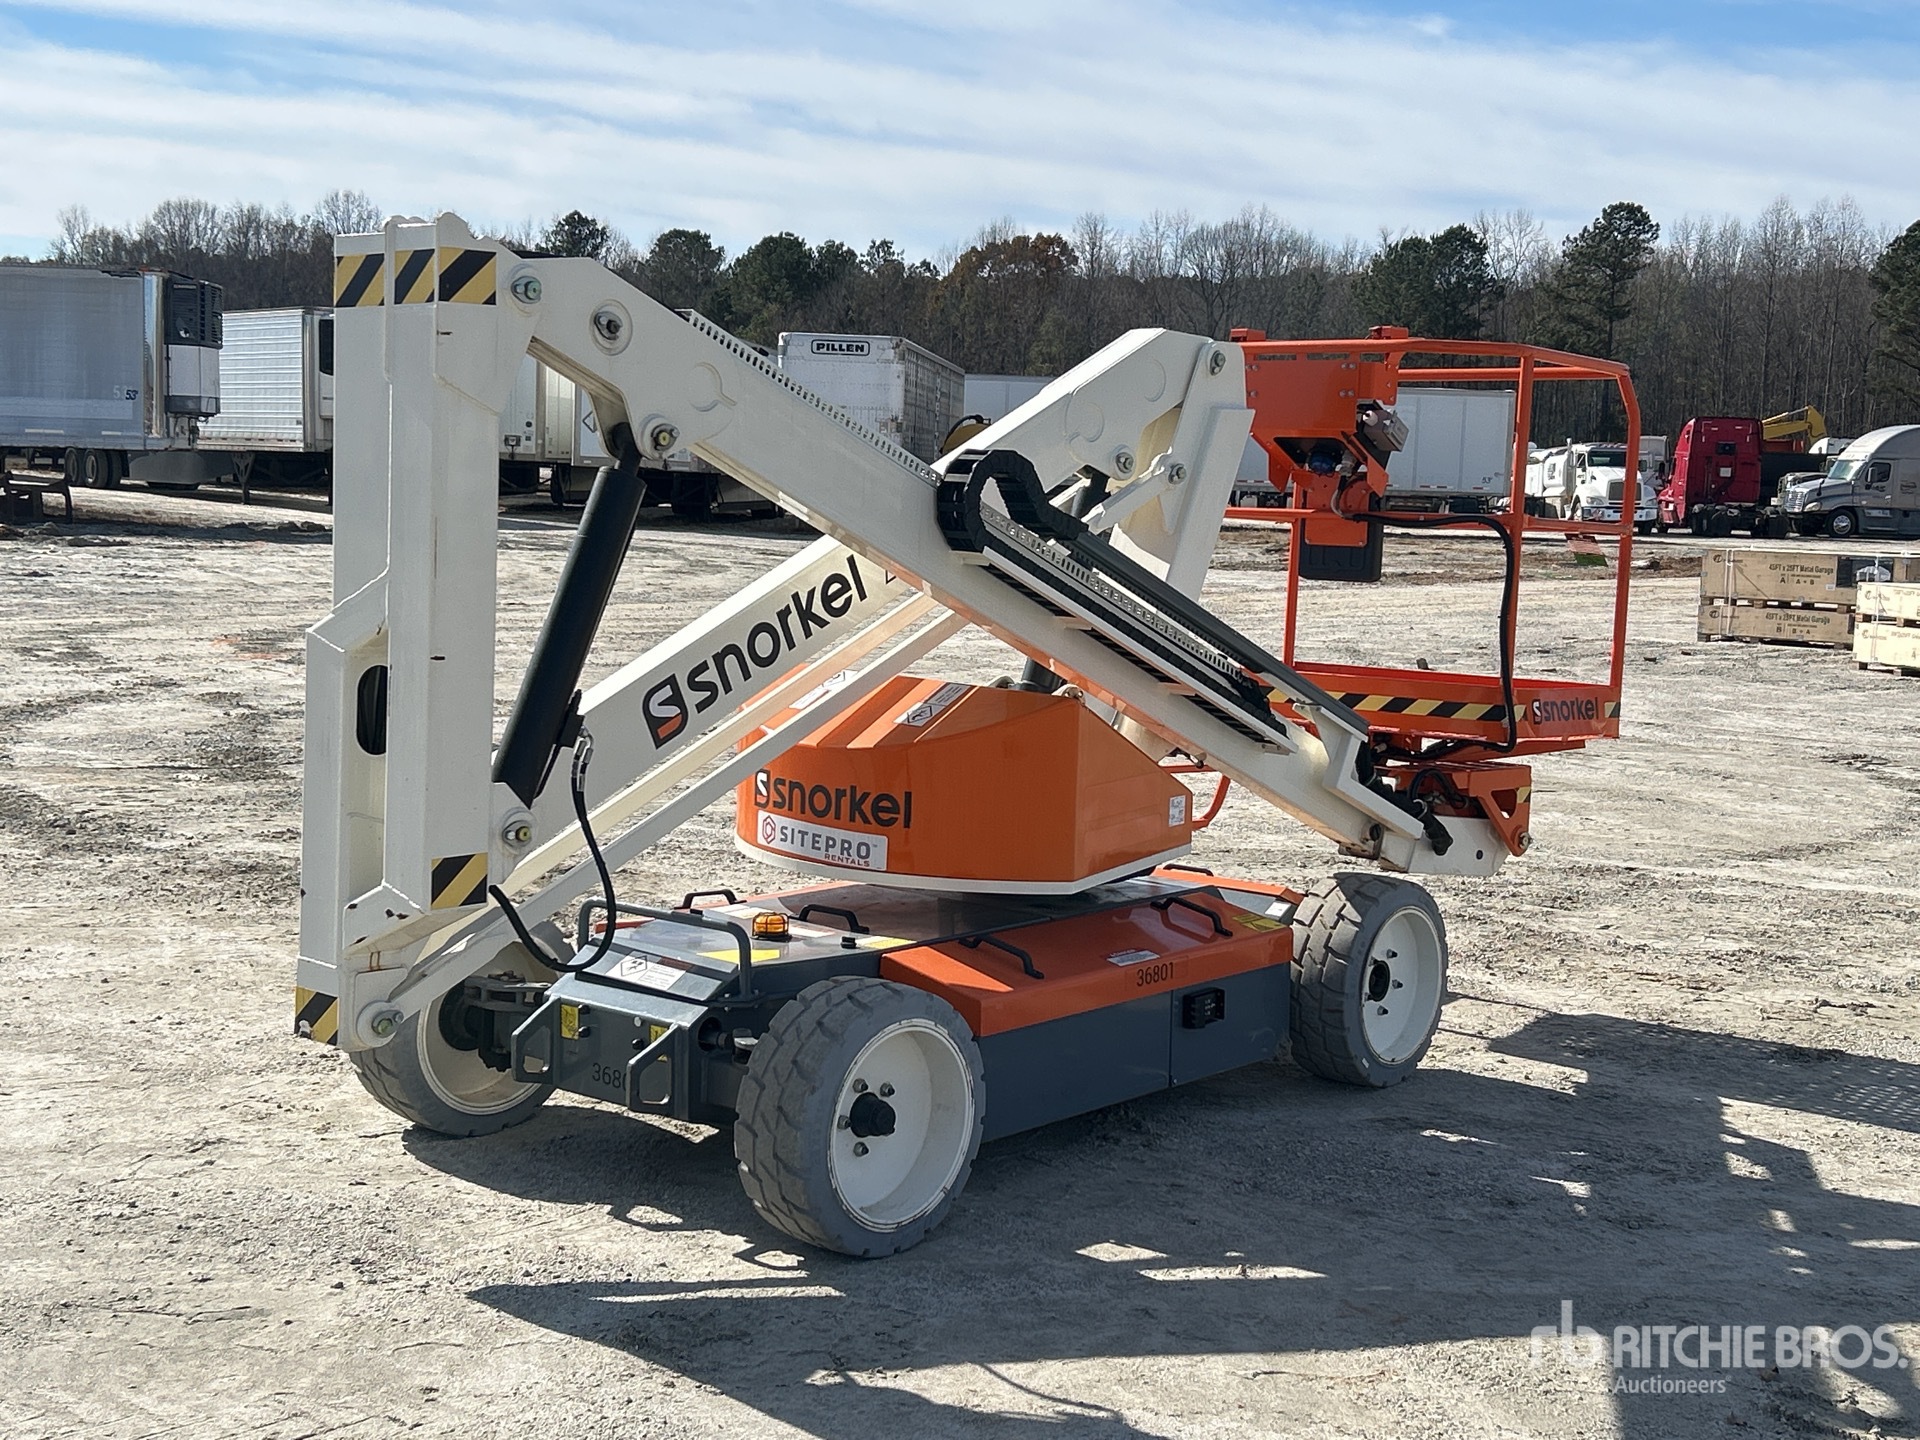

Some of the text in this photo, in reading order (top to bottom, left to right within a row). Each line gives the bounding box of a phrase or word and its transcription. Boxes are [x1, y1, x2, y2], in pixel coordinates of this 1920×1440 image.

[815, 342, 865, 353] PILLEN
[687, 554, 868, 714] snorkel
[1542, 697, 1599, 722] snorkel
[773, 777, 912, 829] snorkel
[824, 853, 870, 867] RENTALS
[1137, 962, 1174, 987] 36801
[592, 1062, 627, 1091] 368
